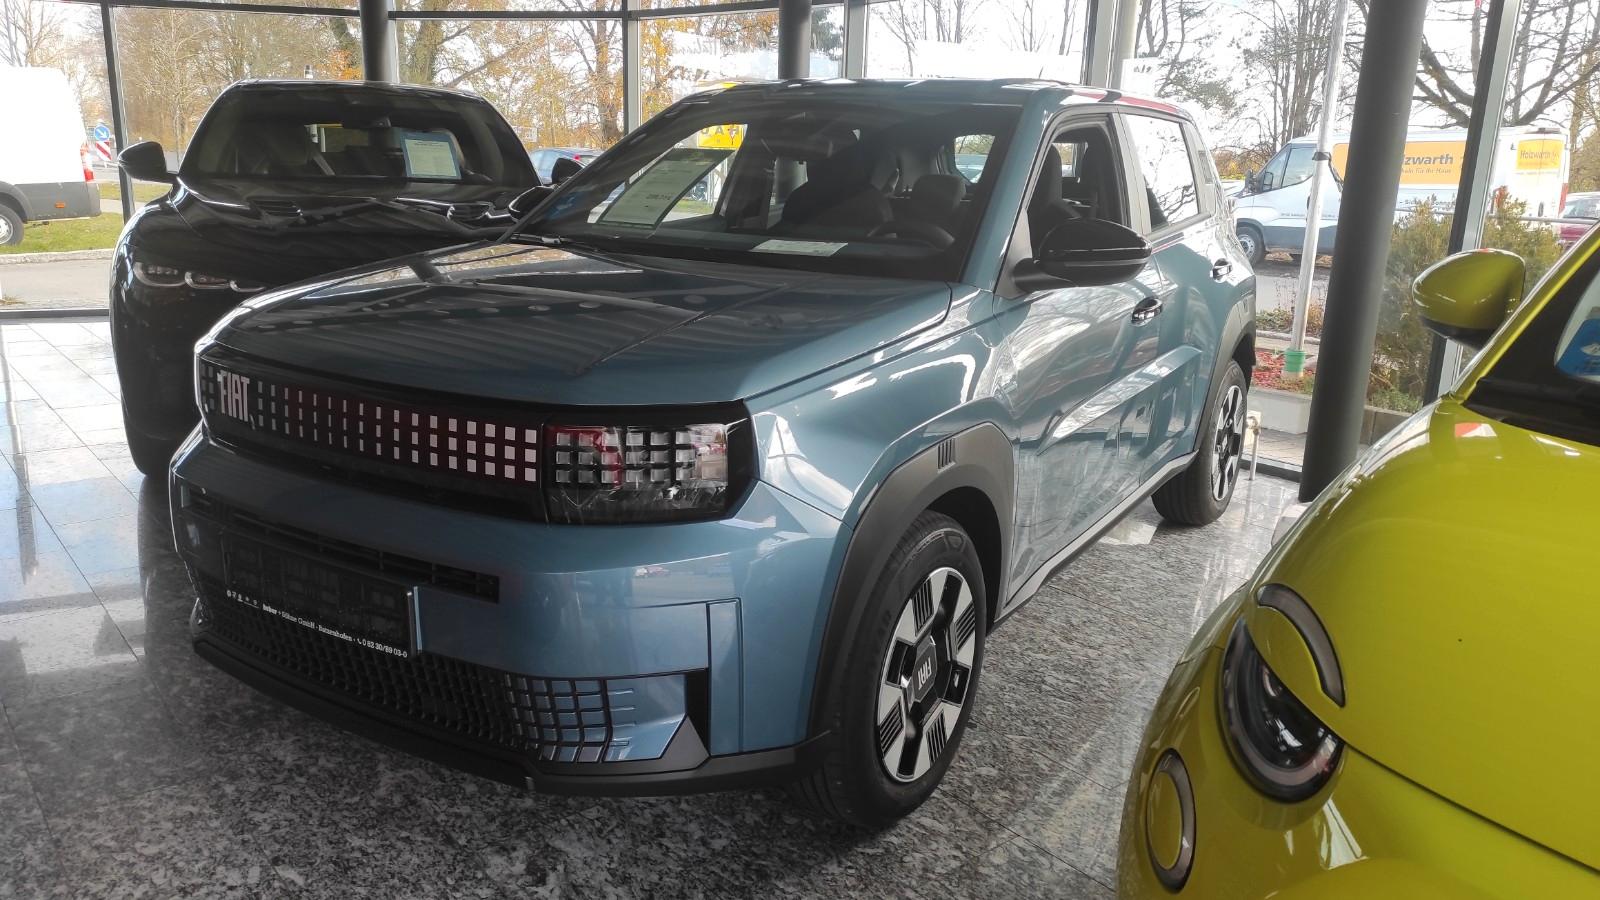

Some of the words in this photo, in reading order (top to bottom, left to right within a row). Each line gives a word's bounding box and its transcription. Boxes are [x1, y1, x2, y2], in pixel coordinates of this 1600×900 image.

[1404, 153, 1454, 165] zwarth
[217, 370, 250, 422] FIAT
[298, 617, 316, 629] GmbH
[918, 656, 932, 690] FIAT
